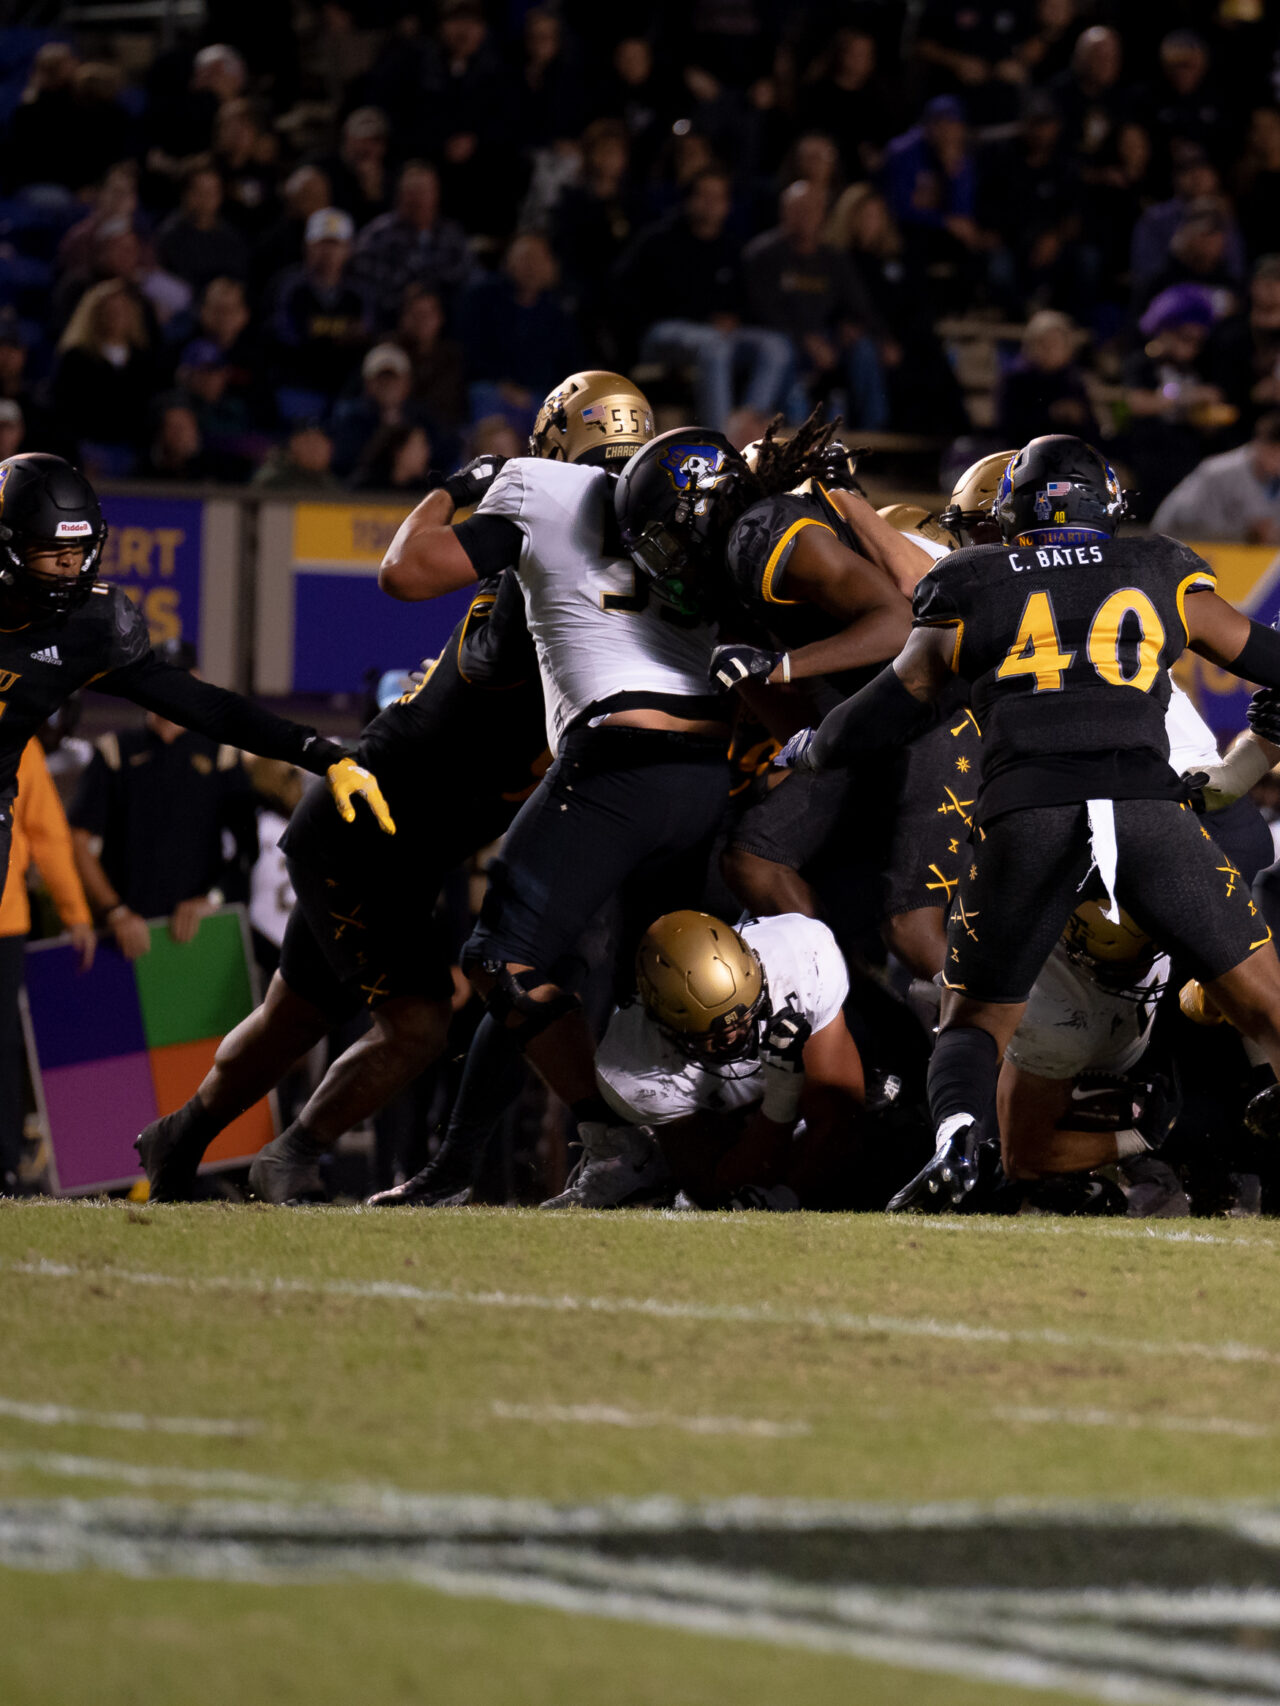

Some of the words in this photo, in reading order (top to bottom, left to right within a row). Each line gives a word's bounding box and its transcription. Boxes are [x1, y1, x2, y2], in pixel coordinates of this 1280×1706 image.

[611, 409, 639, 433] 55
[1053, 511, 1067, 523] 40
[61, 523, 88, 532] Riddell
[1019, 535, 1034, 547] NO
[101, 526, 186, 578] ERT
[1009, 553, 1032, 572] C.
[1035, 546, 1103, 568] BATES
[995, 587, 1167, 695] 40
[30, 651, 63, 667] adidas
